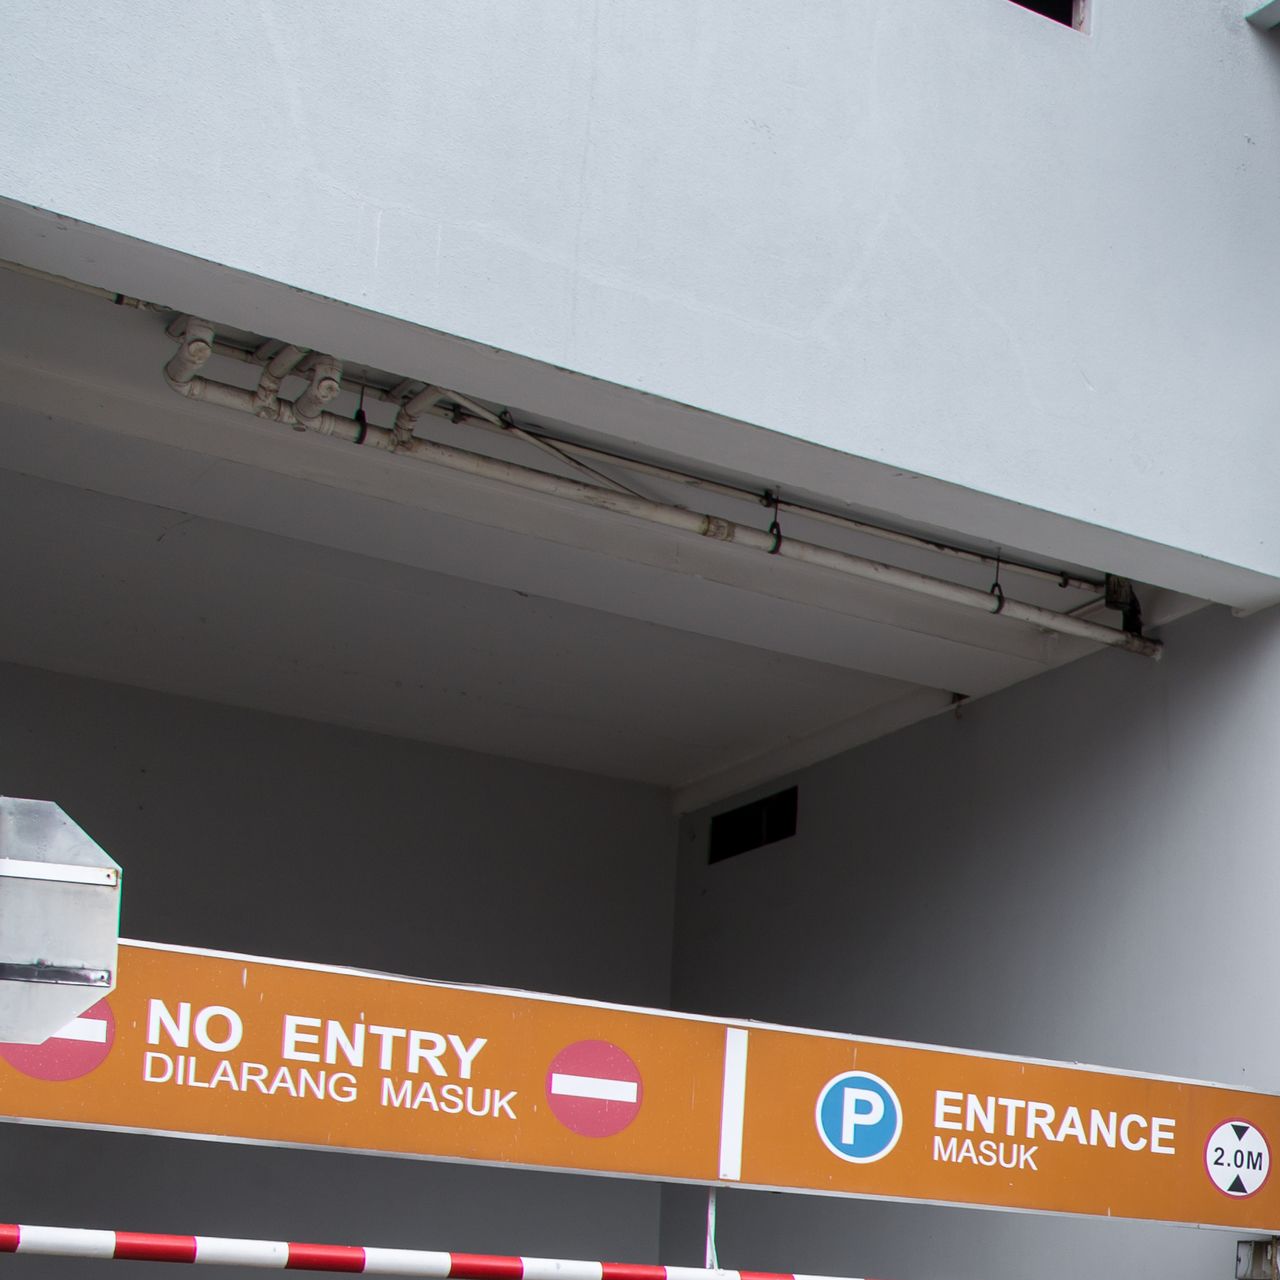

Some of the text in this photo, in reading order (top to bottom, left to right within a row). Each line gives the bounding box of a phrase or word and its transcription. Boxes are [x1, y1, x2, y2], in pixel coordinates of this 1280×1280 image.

[146, 998, 488, 1080] NO ENTRY
[143, 1051, 518, 1120] DILARANG MASUK
[840, 1087, 885, 1146] P
[932, 1135, 1039, 1171] MASUK
[933, 1089, 1176, 1155] ENTRANCE
[1213, 1147, 1264, 1172] 2.0M
